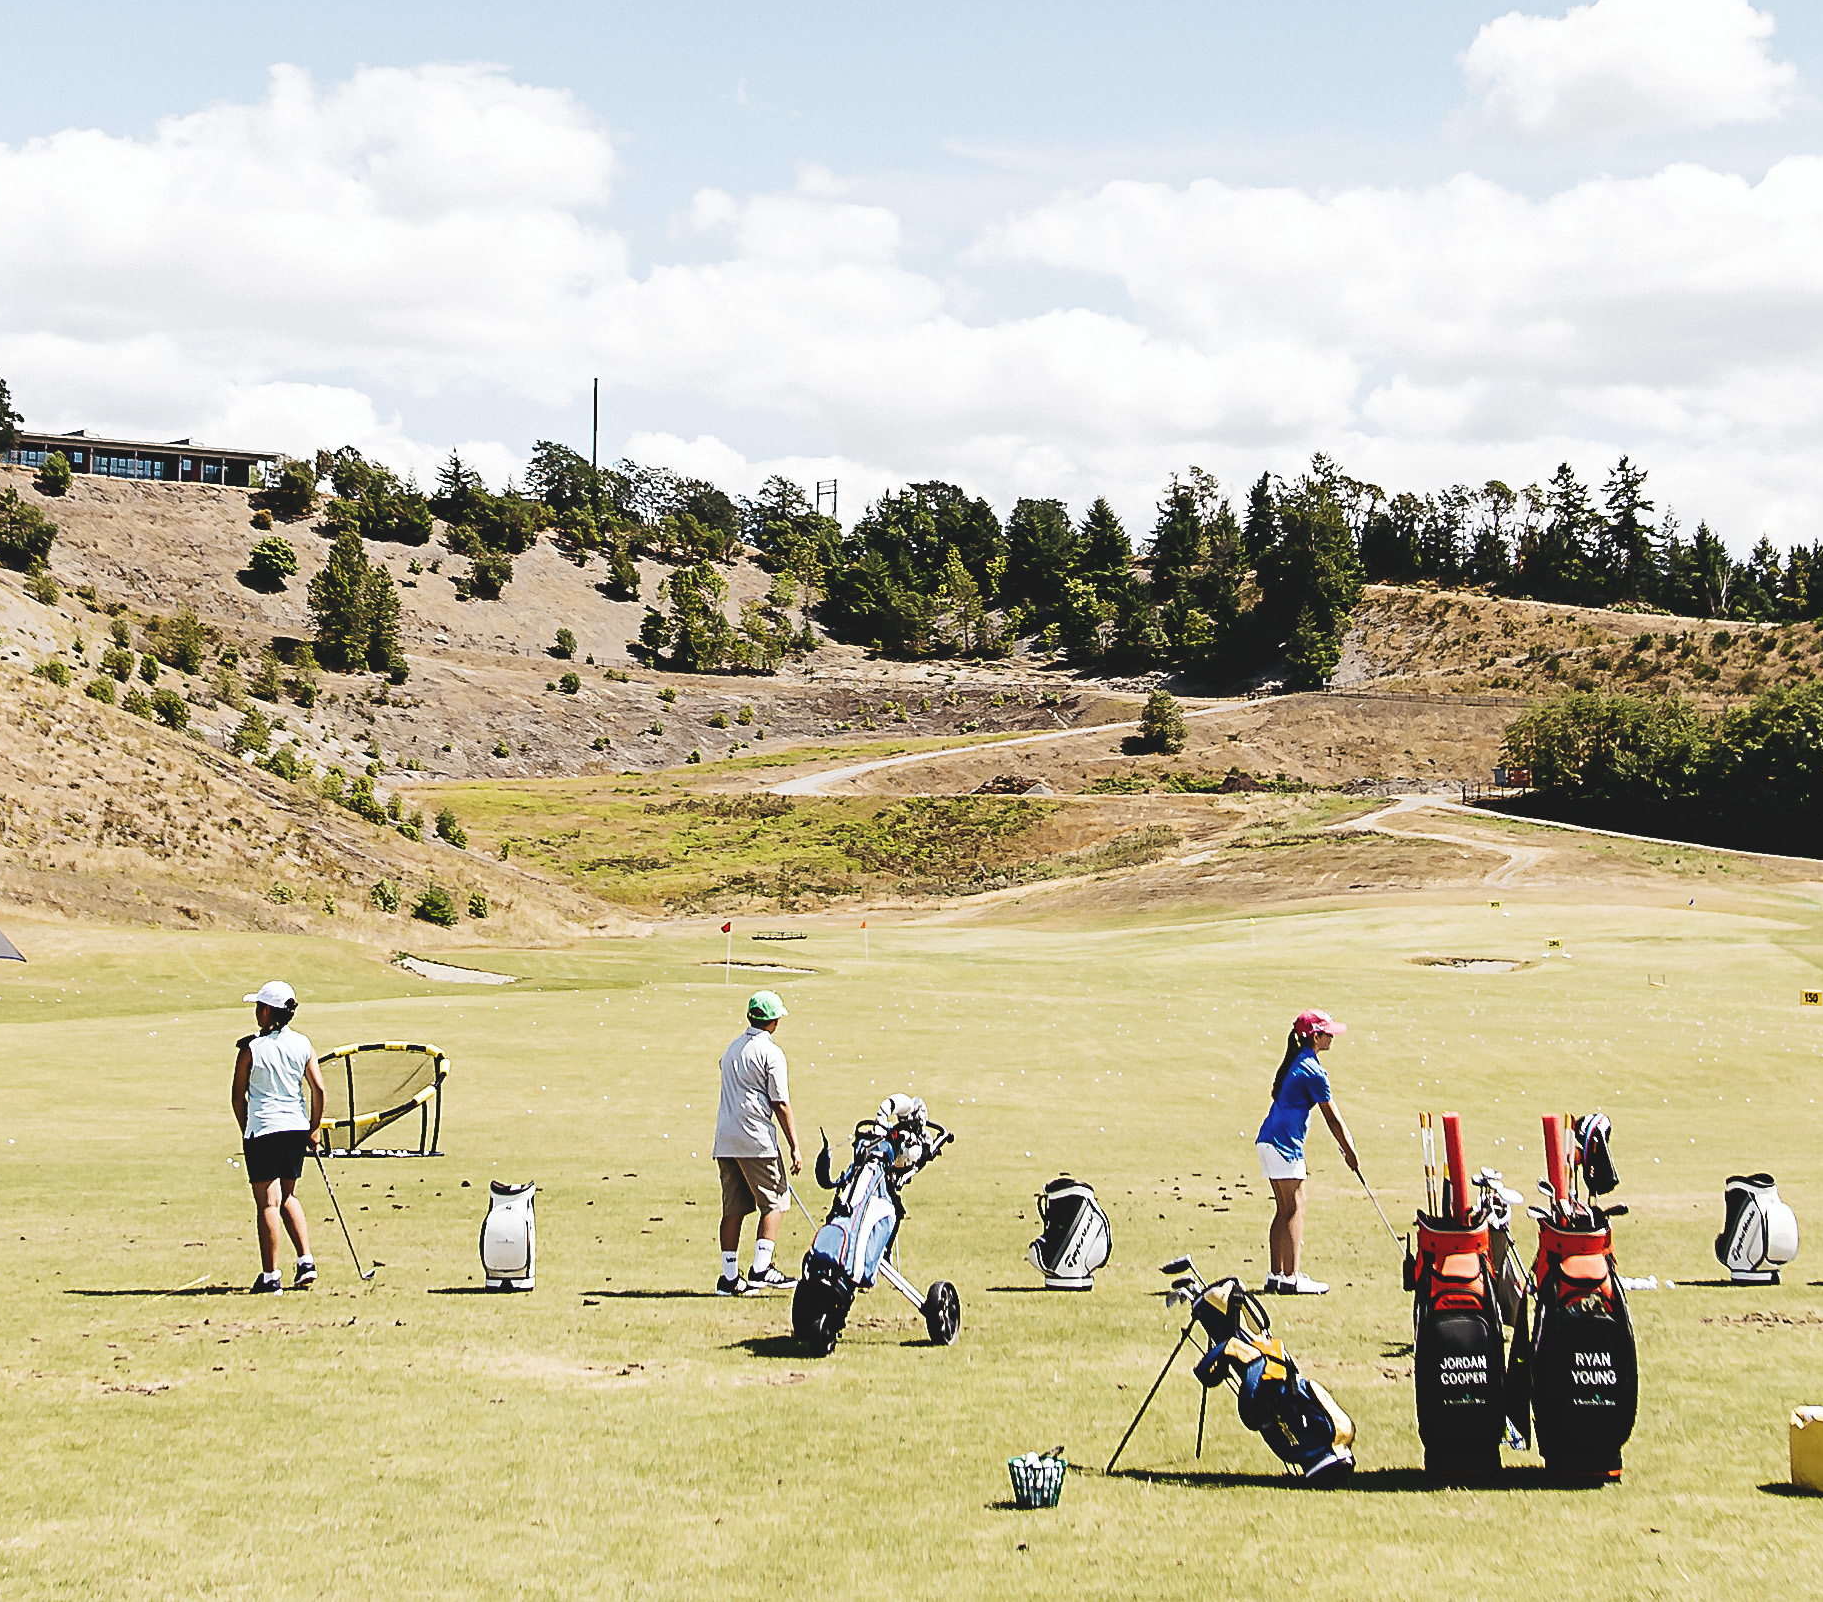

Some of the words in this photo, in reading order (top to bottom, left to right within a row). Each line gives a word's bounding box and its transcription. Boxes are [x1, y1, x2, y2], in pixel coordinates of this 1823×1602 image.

[1804, 991, 1819, 1004] 150
[1440, 1355, 1488, 1370] JORDAN
[1574, 1351, 1612, 1367] RYAN
[1440, 1371, 1488, 1385] COOPER
[1570, 1369, 1617, 1386] YOUNG
